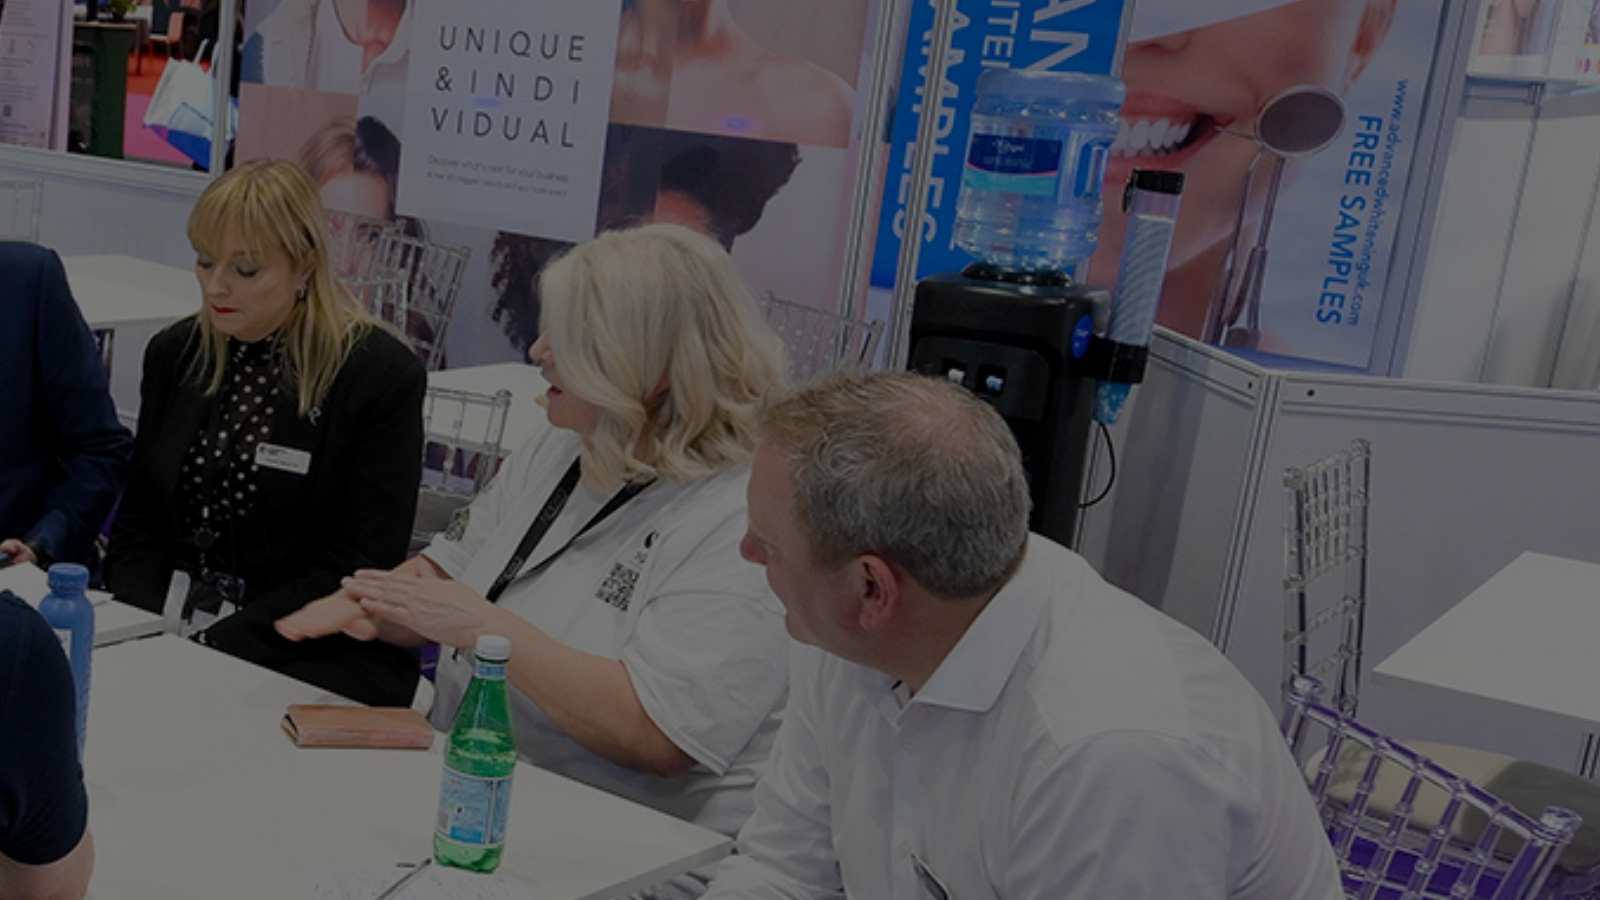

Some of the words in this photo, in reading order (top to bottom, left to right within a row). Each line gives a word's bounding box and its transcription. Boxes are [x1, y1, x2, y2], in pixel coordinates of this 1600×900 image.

[439, 26, 585, 62] UNIQUE
[435, 66, 453, 92] &
[431, 107, 574, 148] VIDUAL
[1344, 115, 1383, 187] FREE
[1348, 79, 1408, 327] www.advancedwhiteninguk.com
[1316, 194, 1367, 325] SAMPLES
